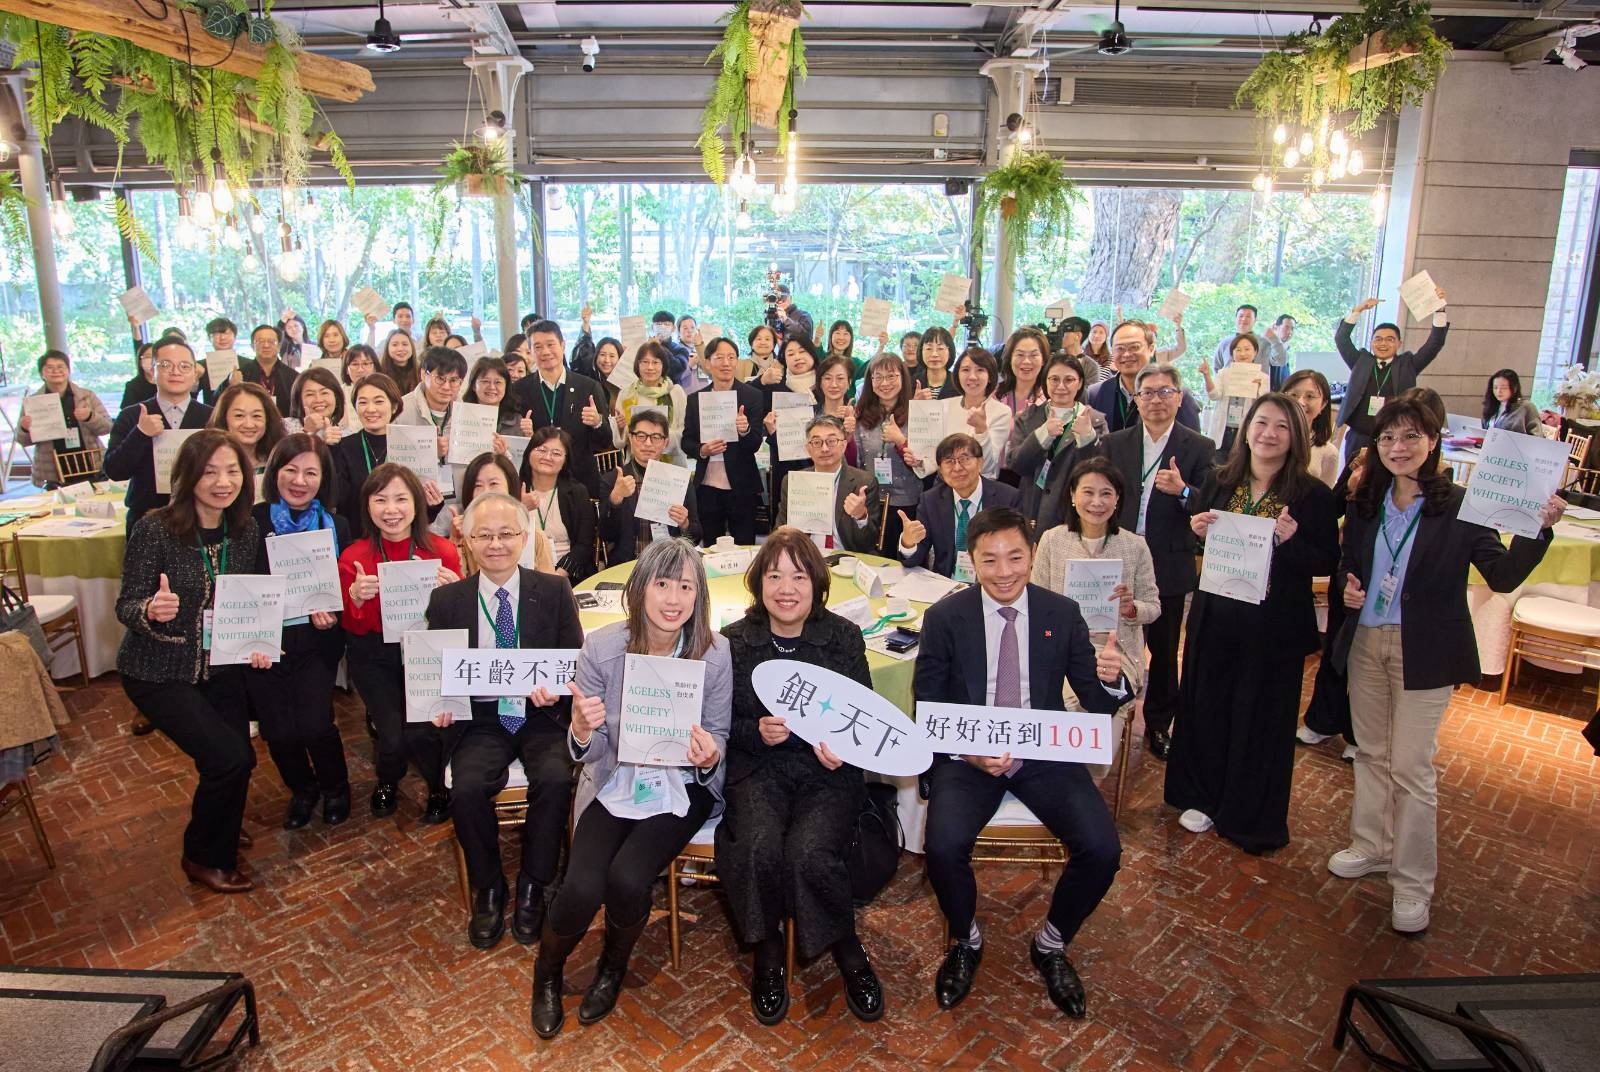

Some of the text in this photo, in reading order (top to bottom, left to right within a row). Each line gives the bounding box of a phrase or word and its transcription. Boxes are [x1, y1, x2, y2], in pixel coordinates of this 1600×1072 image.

[1484, 455, 1529, 472] AGELESS
[1478, 471, 1524, 488] SOCIETY
[1472, 488, 1540, 511] WHITEPAPER
[1210, 534, 1245, 546] AGELESS
[1208, 547, 1242, 560] SOCIETY
[274, 556, 312, 568] AGELESS
[287, 570, 312, 580] CIETY
[1206, 562, 1258, 580] WHITEPAPER
[287, 582, 334, 595] HITEPAPER
[384, 584, 419, 594] AGELESS
[220, 600, 258, 609] AGELESS
[384, 598, 420, 608] SOCIETY
[218, 616, 257, 625] SOCIETY
[386, 612, 425, 622] WHITEPA
[216, 630, 276, 640] WHITEPAPER
[408, 656, 442, 664] AGELESS
[408, 672, 442, 681] SOCIETY
[454, 658, 577, 686] 年齡不設
[408, 688, 441, 697] WHITEP
[628, 685, 671, 699] AGELESS
[626, 704, 671, 717] SOCIETY
[625, 722, 691, 738] WHITEPAPER
[926, 714, 1103, 750] 好好活到101
